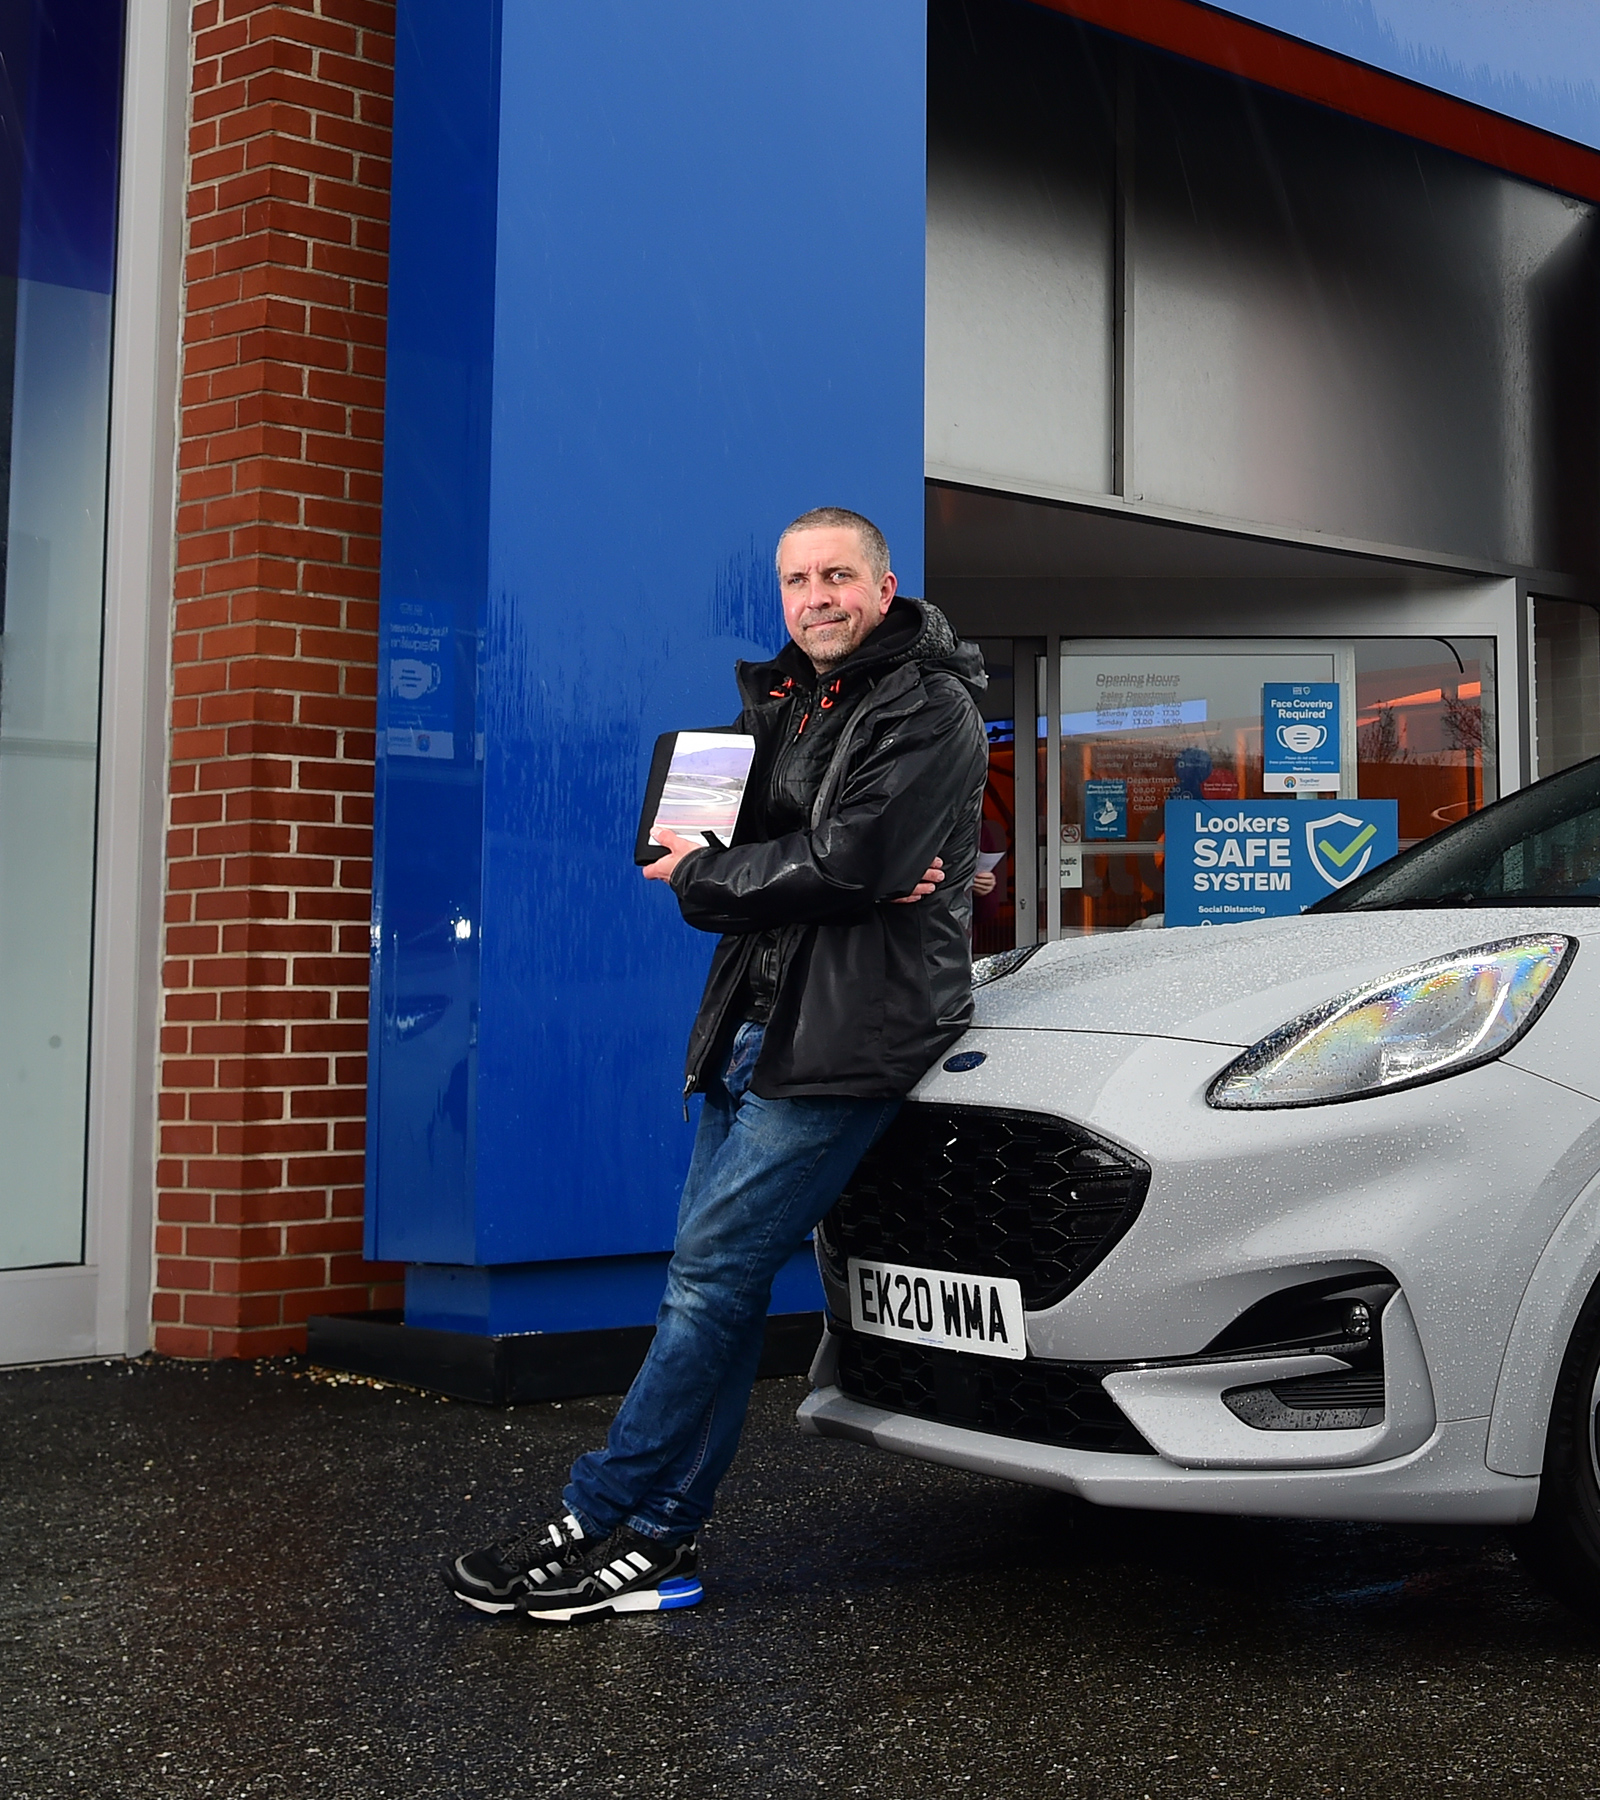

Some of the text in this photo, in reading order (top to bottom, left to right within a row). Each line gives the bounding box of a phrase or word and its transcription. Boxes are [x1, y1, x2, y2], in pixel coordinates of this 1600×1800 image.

[1270, 699, 1333, 710] Face Covering
[1278, 709, 1326, 720] Required
[1127, 776, 1178, 785] Department
[1195, 811, 1291, 833] Lookers
[1193, 838, 1292, 868] SAFE
[1193, 872, 1291, 892] SYSTEM
[1198, 905, 1266, 915] Social Distancing
[858, 1267, 1009, 1344] EK20 WMA
